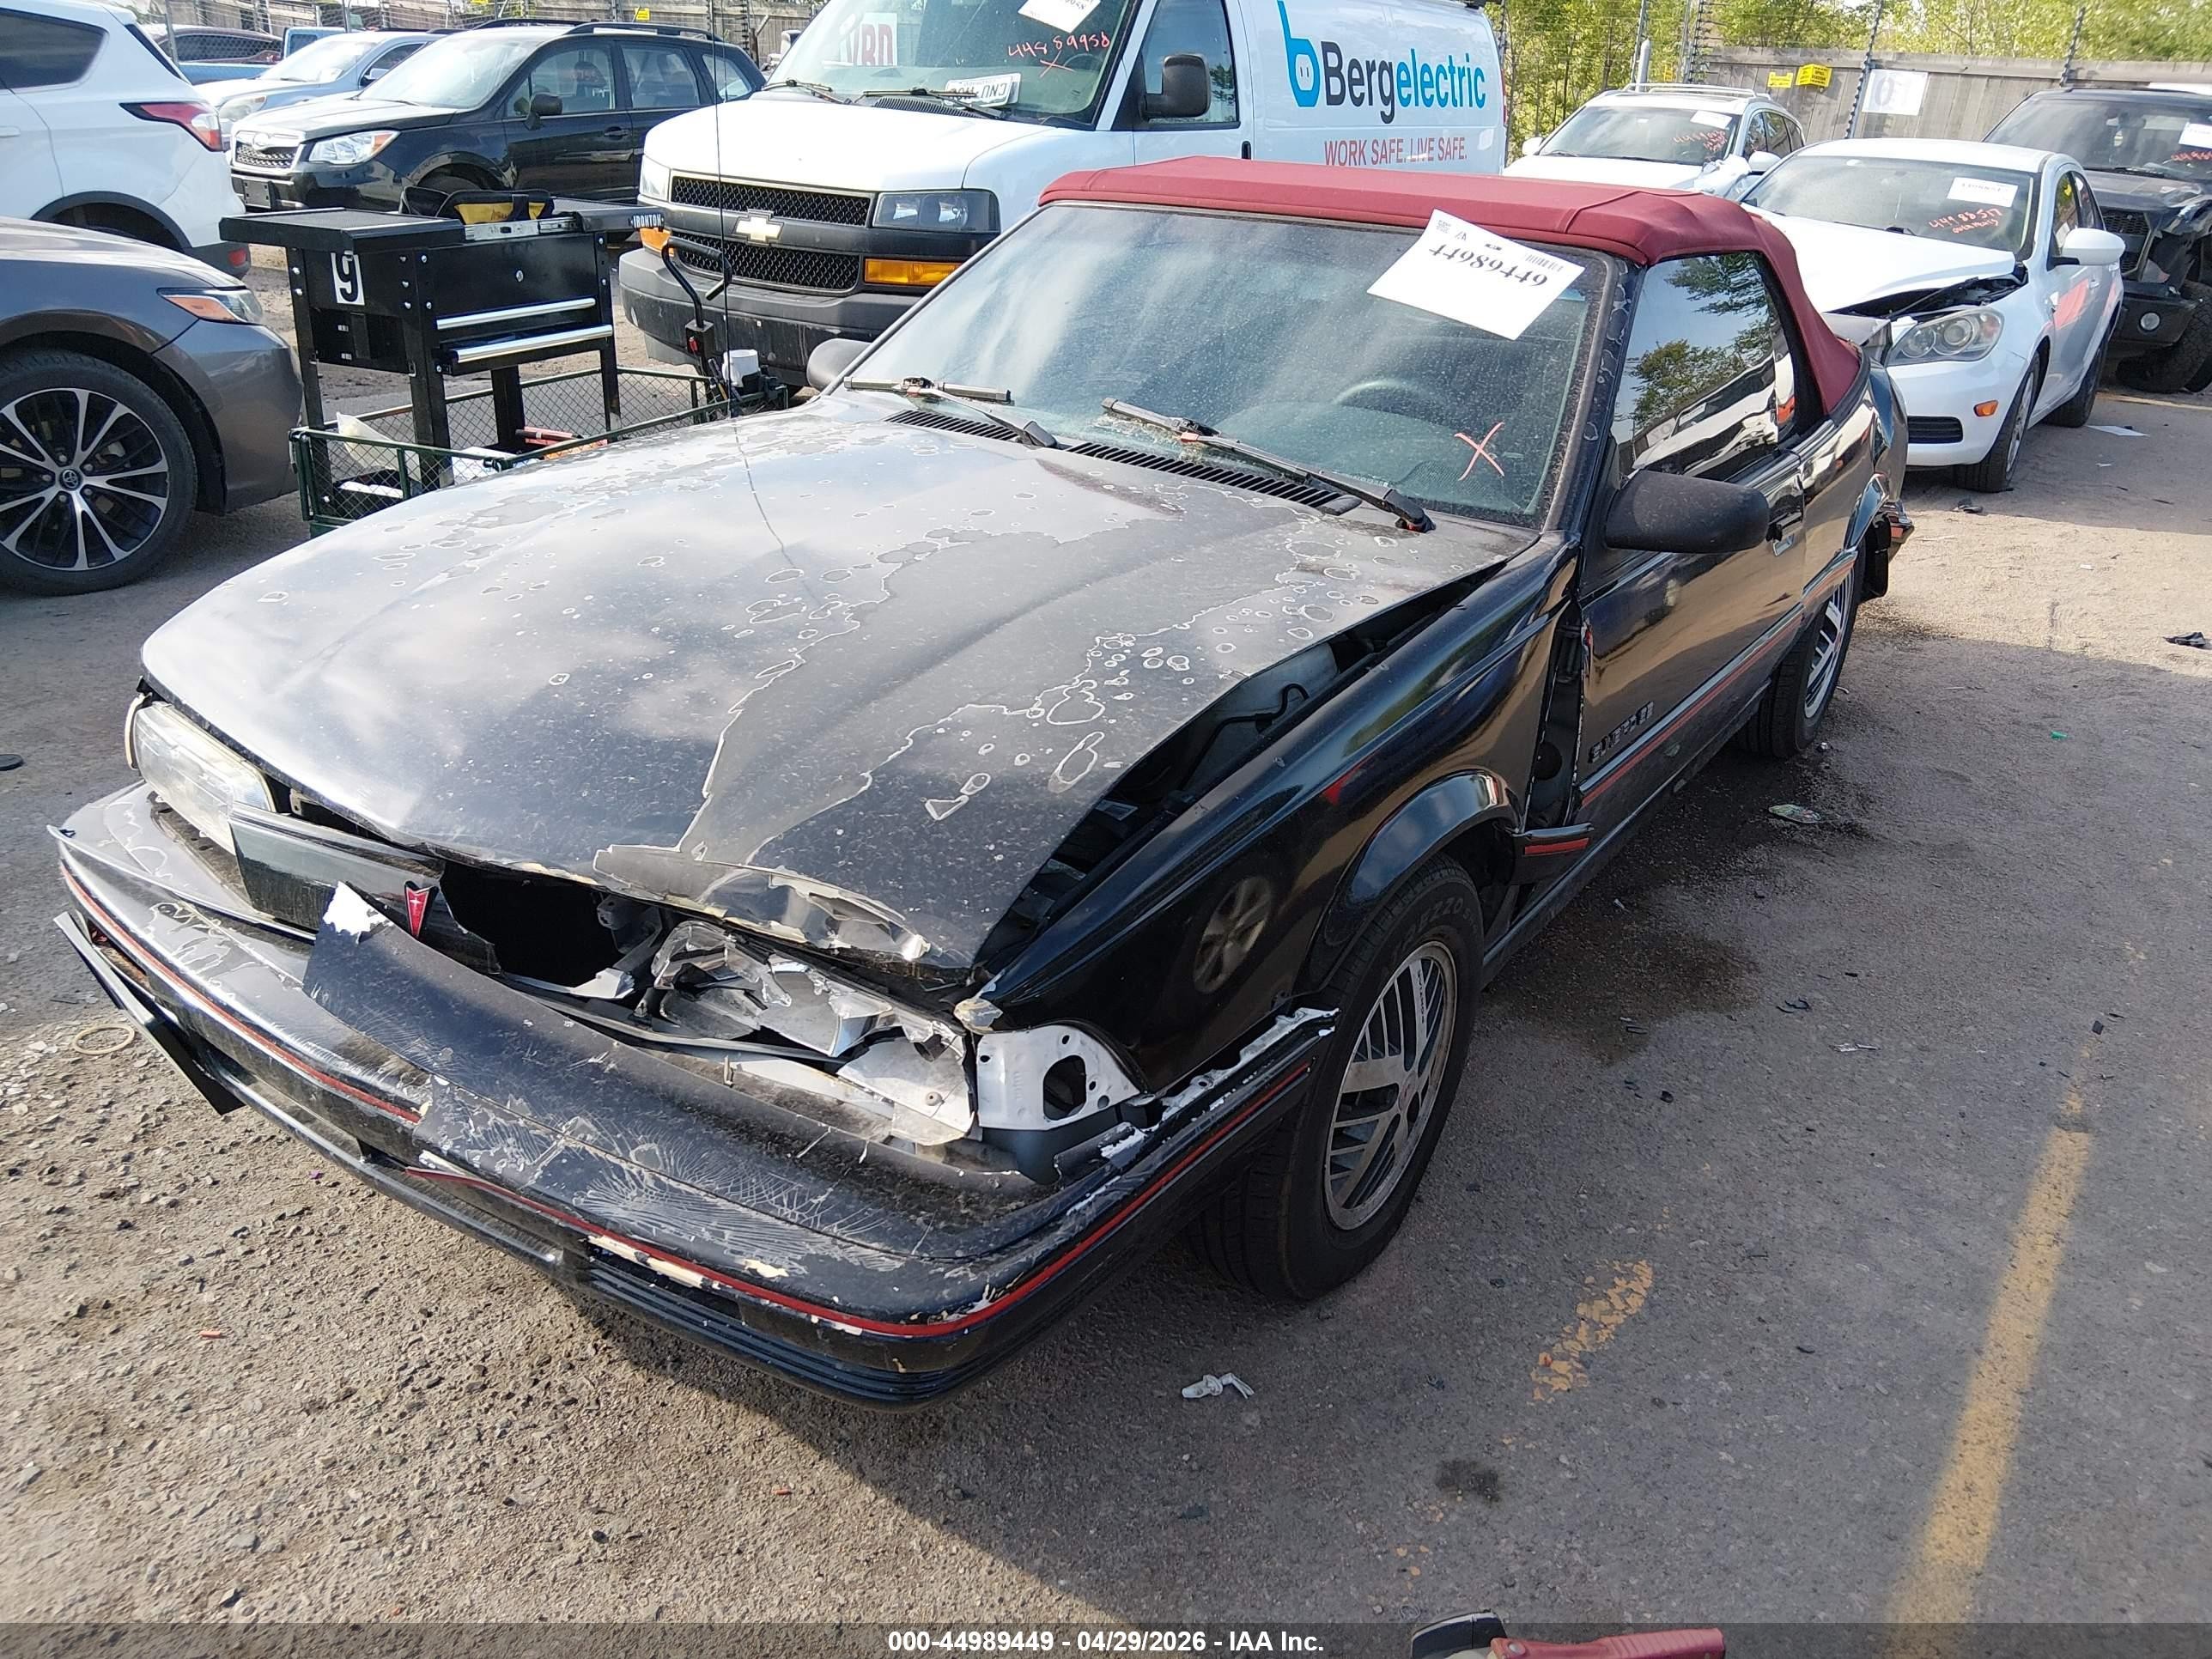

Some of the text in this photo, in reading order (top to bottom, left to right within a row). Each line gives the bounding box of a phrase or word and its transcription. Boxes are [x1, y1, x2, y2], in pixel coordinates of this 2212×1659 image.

[1321, 41, 1486, 125] Bergelectric
[1324, 137, 1468, 167] WORK SAFE. LIVE SAFE.
[633, 213, 661, 228] IRONTON
[1429, 244, 1548, 287] 44989449
